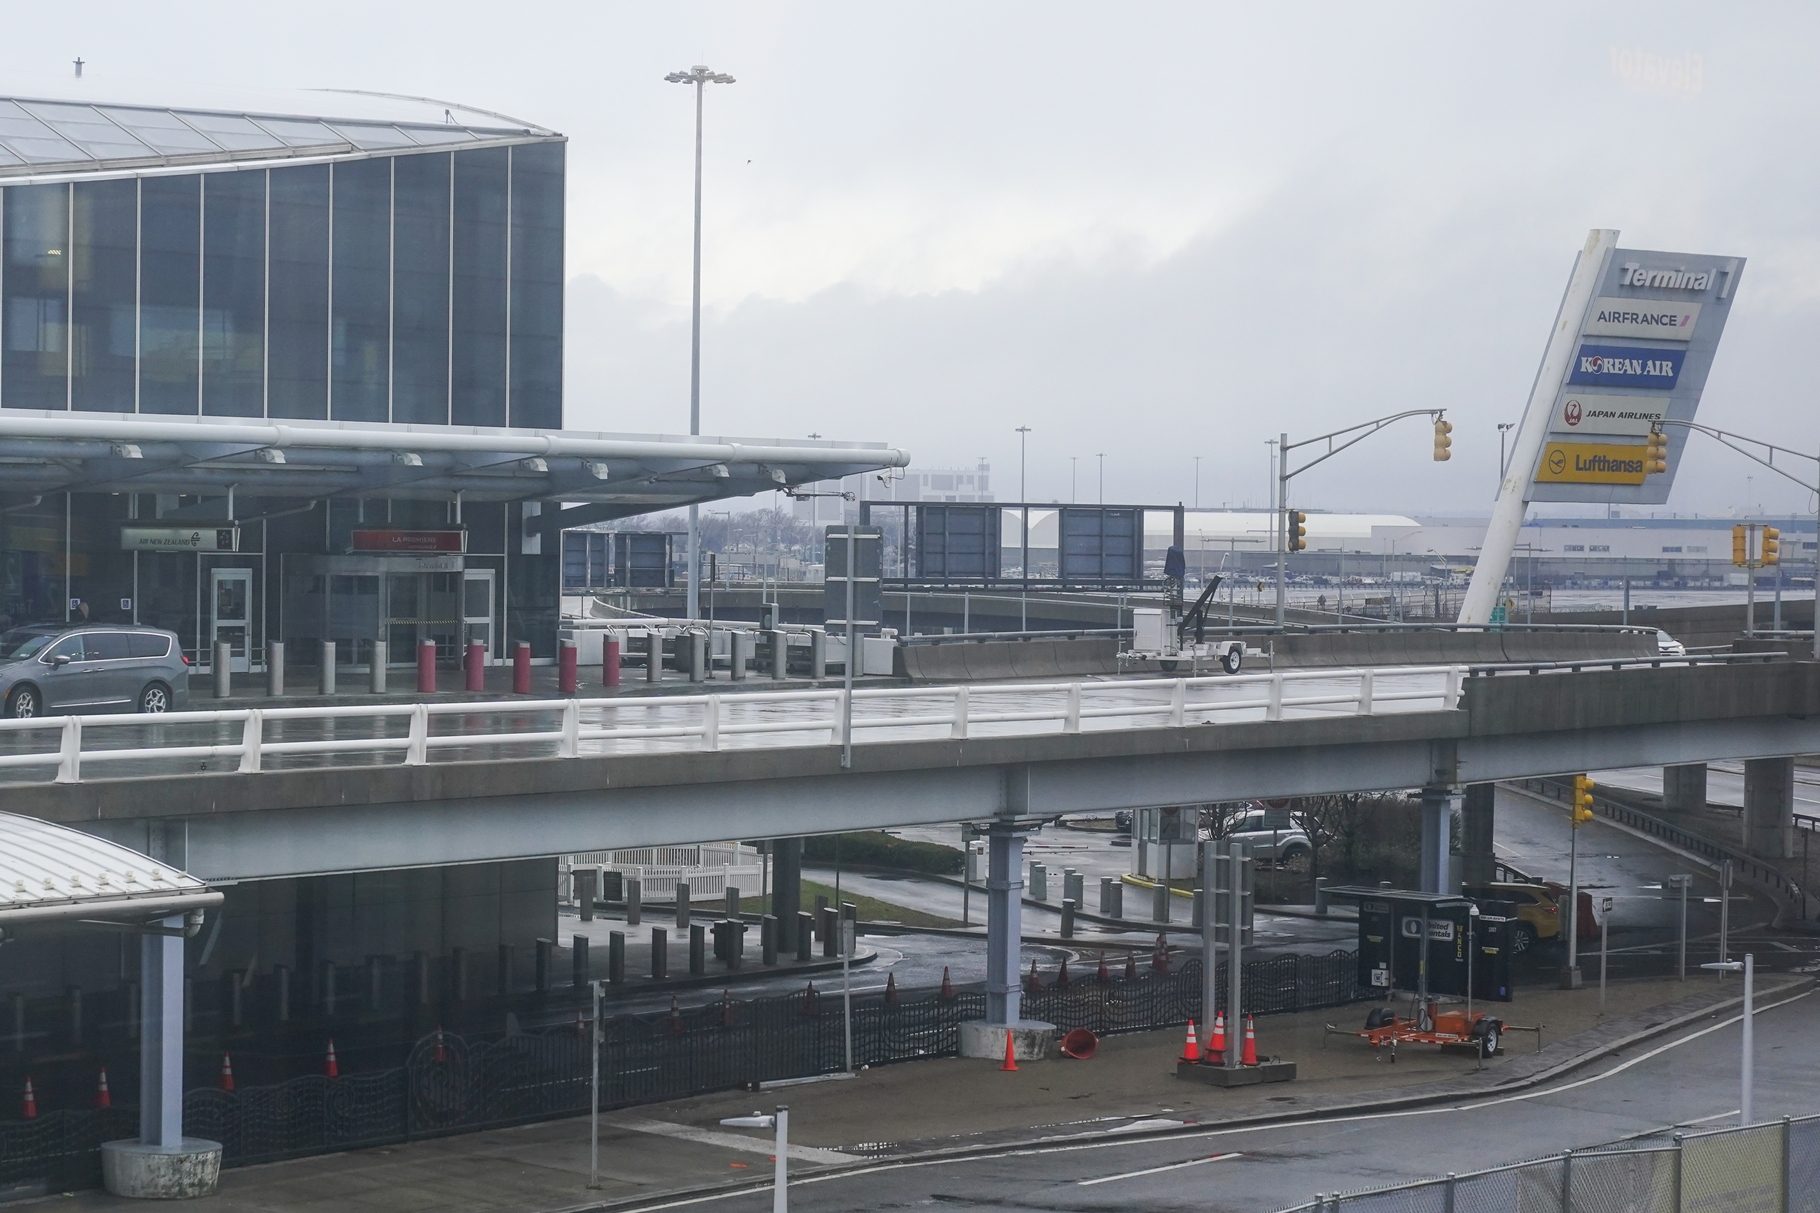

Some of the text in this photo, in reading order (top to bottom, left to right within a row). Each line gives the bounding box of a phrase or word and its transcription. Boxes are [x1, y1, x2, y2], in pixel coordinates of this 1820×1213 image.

[1623, 259, 1739, 298] Terminal 1
[1597, 311, 1678, 326] AIRFRANCE
[1580, 356, 1674, 376] KOREAN AIR
[1586, 410, 1661, 420] JAPAN AIRLINES
[1575, 455, 1643, 472] Lufthansa
[1428, 930, 1451, 938] entals
